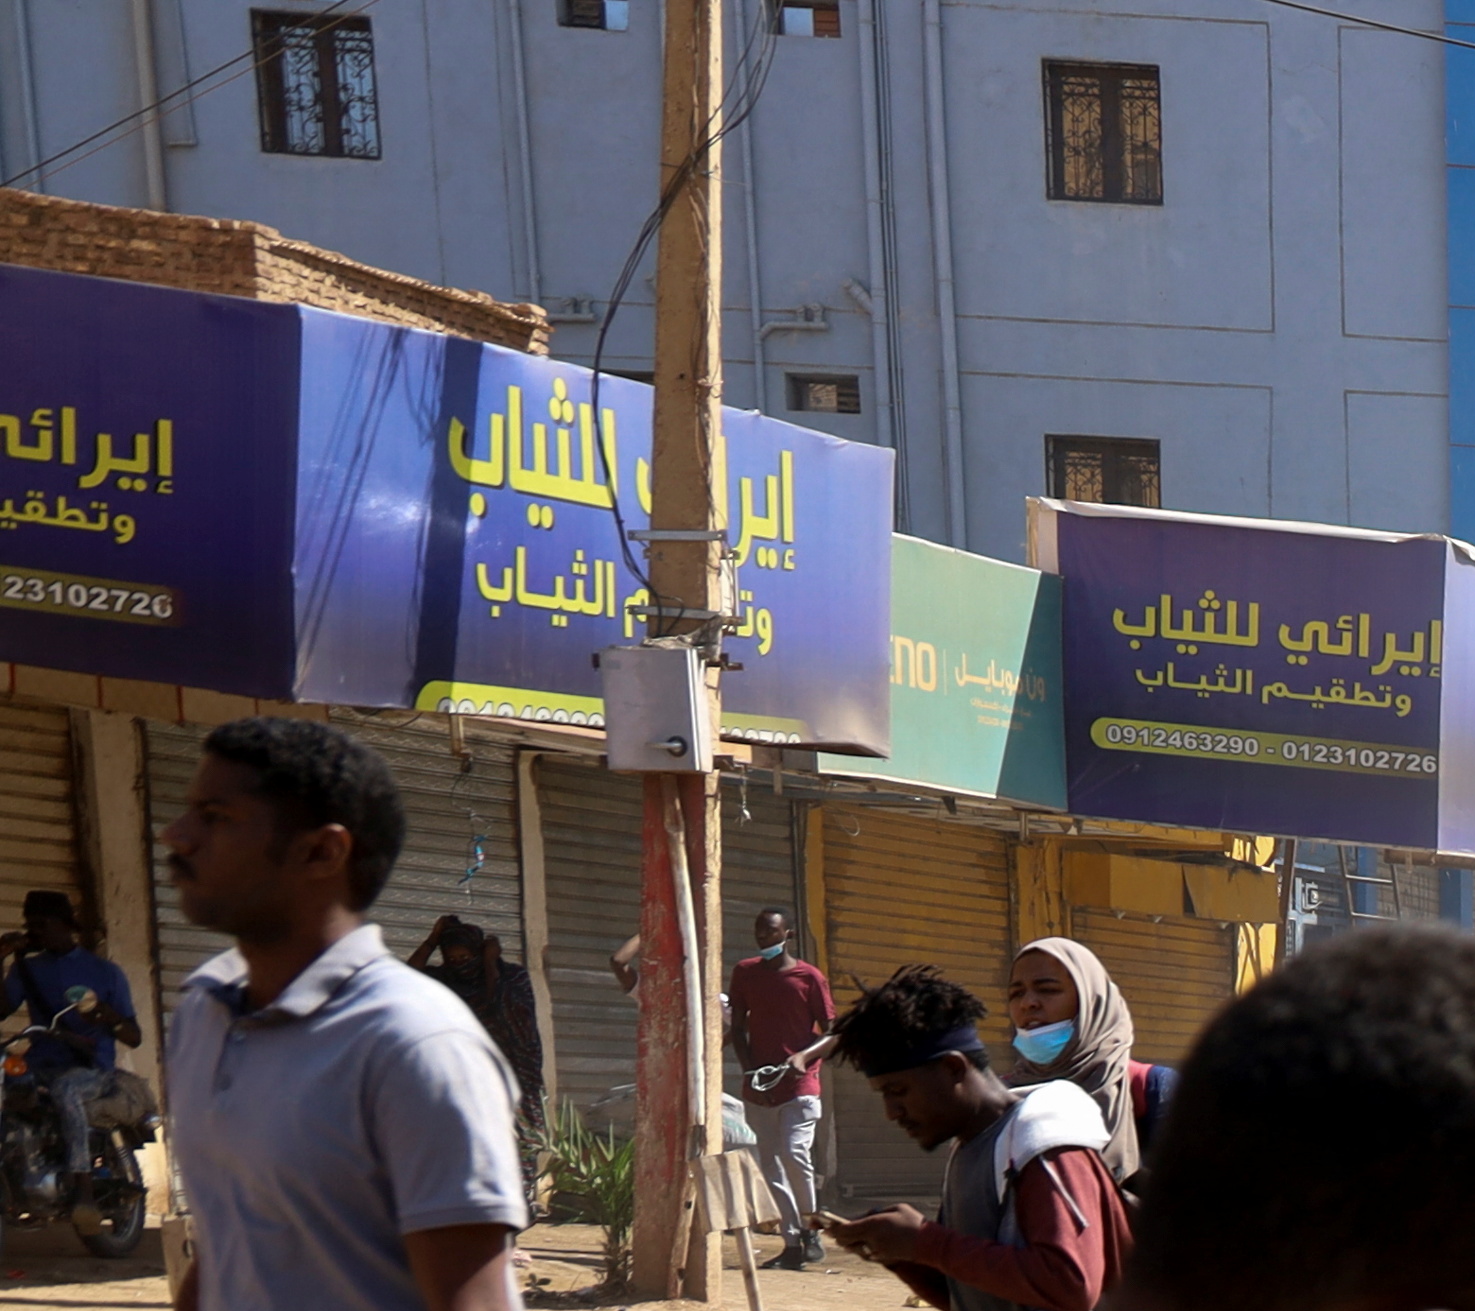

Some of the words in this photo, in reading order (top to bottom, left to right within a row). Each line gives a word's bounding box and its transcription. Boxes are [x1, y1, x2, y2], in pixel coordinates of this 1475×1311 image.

[448, 377, 618, 529] للثياب
[0, 489, 137, 545] وتطقي
[636, 434, 796, 572] إيرا
[4, 575, 174, 620] 23102726
[476, 545, 616, 627] الثياب
[1112, 589, 1260, 651] للثياب
[1278, 612, 1442, 678] إيرائي
[890, 634, 938, 693] NO
[1135, 661, 1254, 699] الثياب
[1260, 677, 1413, 718] وتطقيم
[1105, 724, 1259, 757] 0912463290
[1282, 741, 1437, 775] 0123102726
